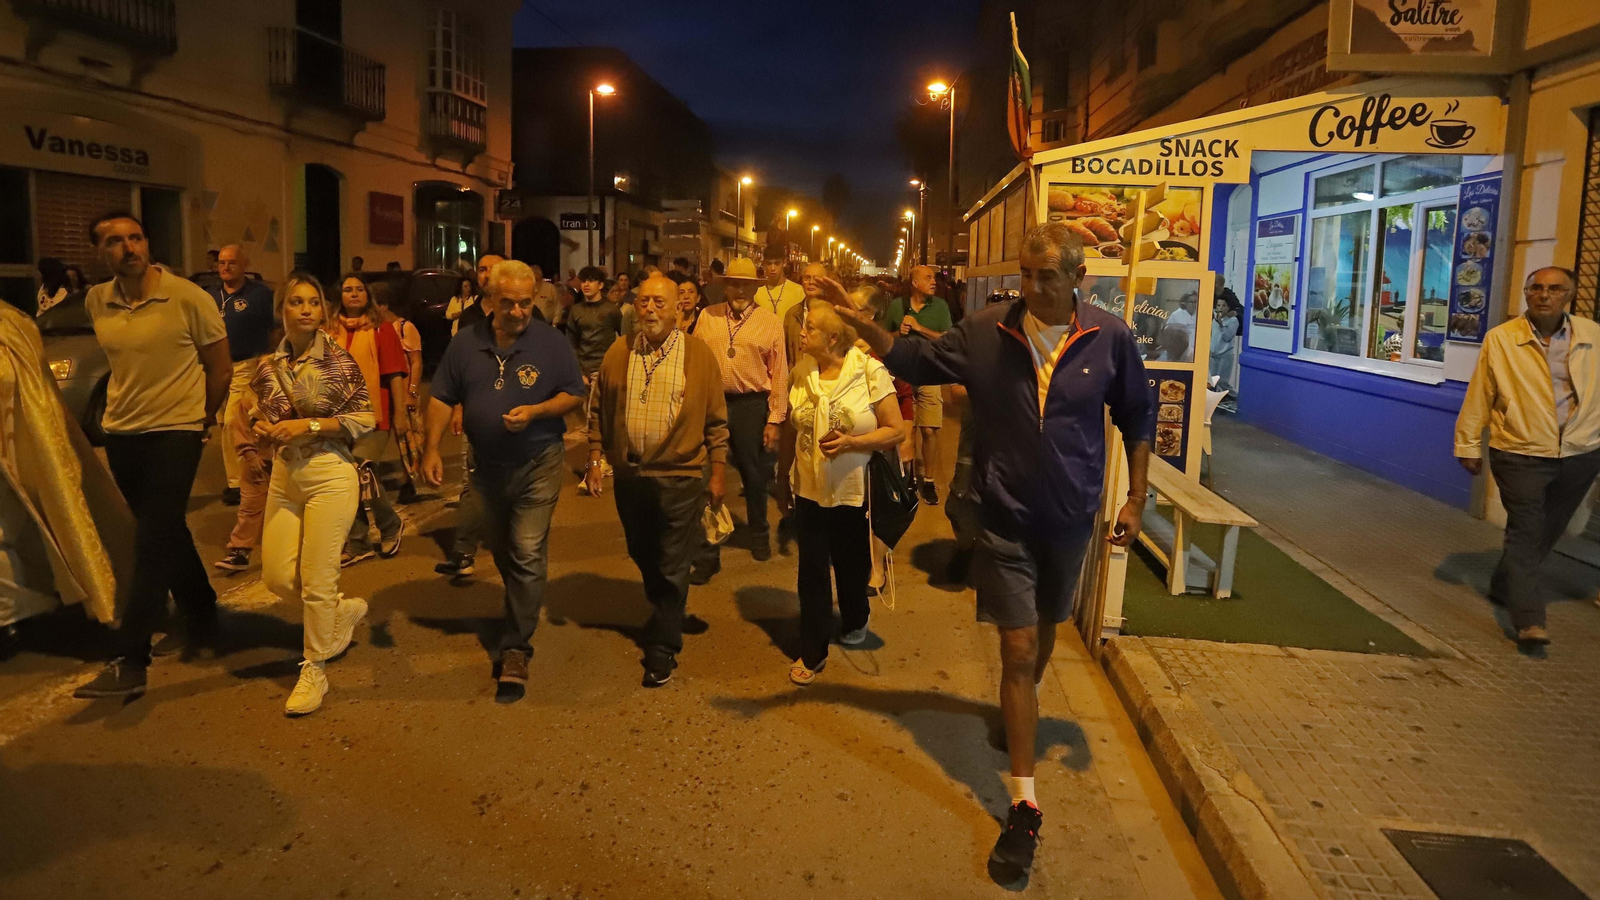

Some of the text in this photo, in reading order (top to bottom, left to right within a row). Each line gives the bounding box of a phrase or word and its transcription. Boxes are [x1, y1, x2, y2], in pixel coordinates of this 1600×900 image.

[1388, 0, 1463, 25] Salitre
[1309, 93, 1433, 147] Coffee
[23, 125, 149, 166] Vanessa
[1159, 138, 1239, 158] SNACK
[1071, 157, 1224, 177] BOCADILLOS
